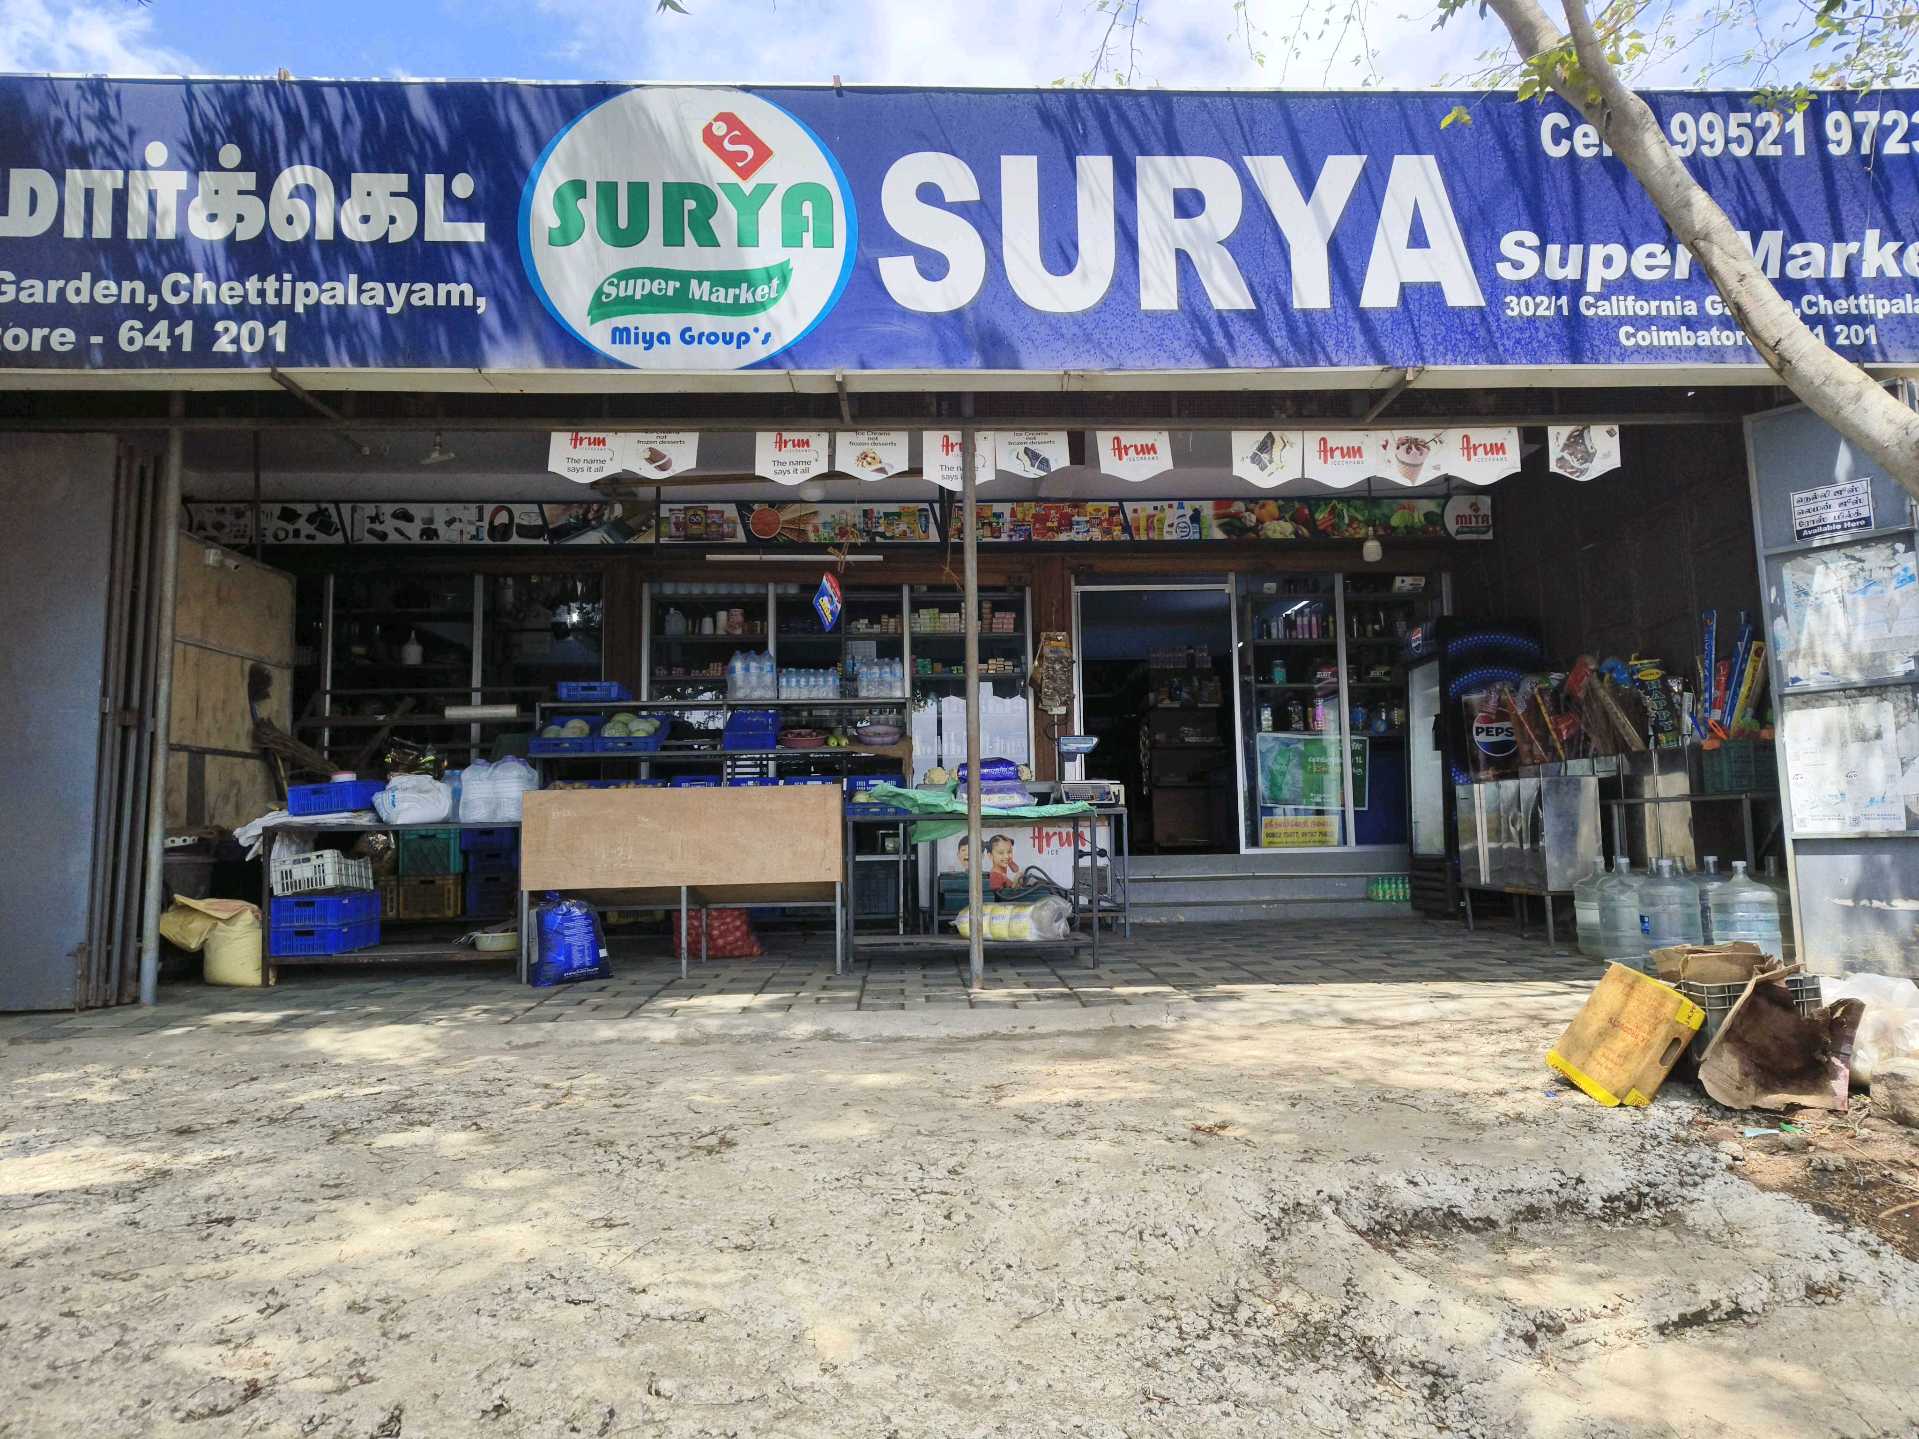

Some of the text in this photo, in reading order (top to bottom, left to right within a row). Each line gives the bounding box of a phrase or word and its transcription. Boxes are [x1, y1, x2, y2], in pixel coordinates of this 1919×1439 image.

[1540, 112, 1612, 158] Ce
[1670, 109, 1805, 157] 99521
[723, 130, 754, 167] S
[548, 179, 835, 248] SURYA
[878, 151, 1486, 313] SURYA
[1496, 230, 1694, 292] Super
[601, 277, 780, 304] Super Market
[1504, 296, 1569, 316] 302/1
[1579, 295, 1698, 316] California
[0, 327, 76, 352] ore
[118, 319, 193, 352] 641
[212, 320, 287, 353] 201
[611, 326, 772, 351] Miya Group's
[1834, 324, 1878, 345] 201
[773, 432, 810, 451] Arun
[1111, 436, 1157, 461] Arun
[1317, 436, 1363, 464] Arun
[1460, 434, 1506, 461] Arun
[1803, 520, 1866, 536] Available Here
[1475, 726, 1514, 737] PEPS
[1030, 823, 1086, 854] Arun
